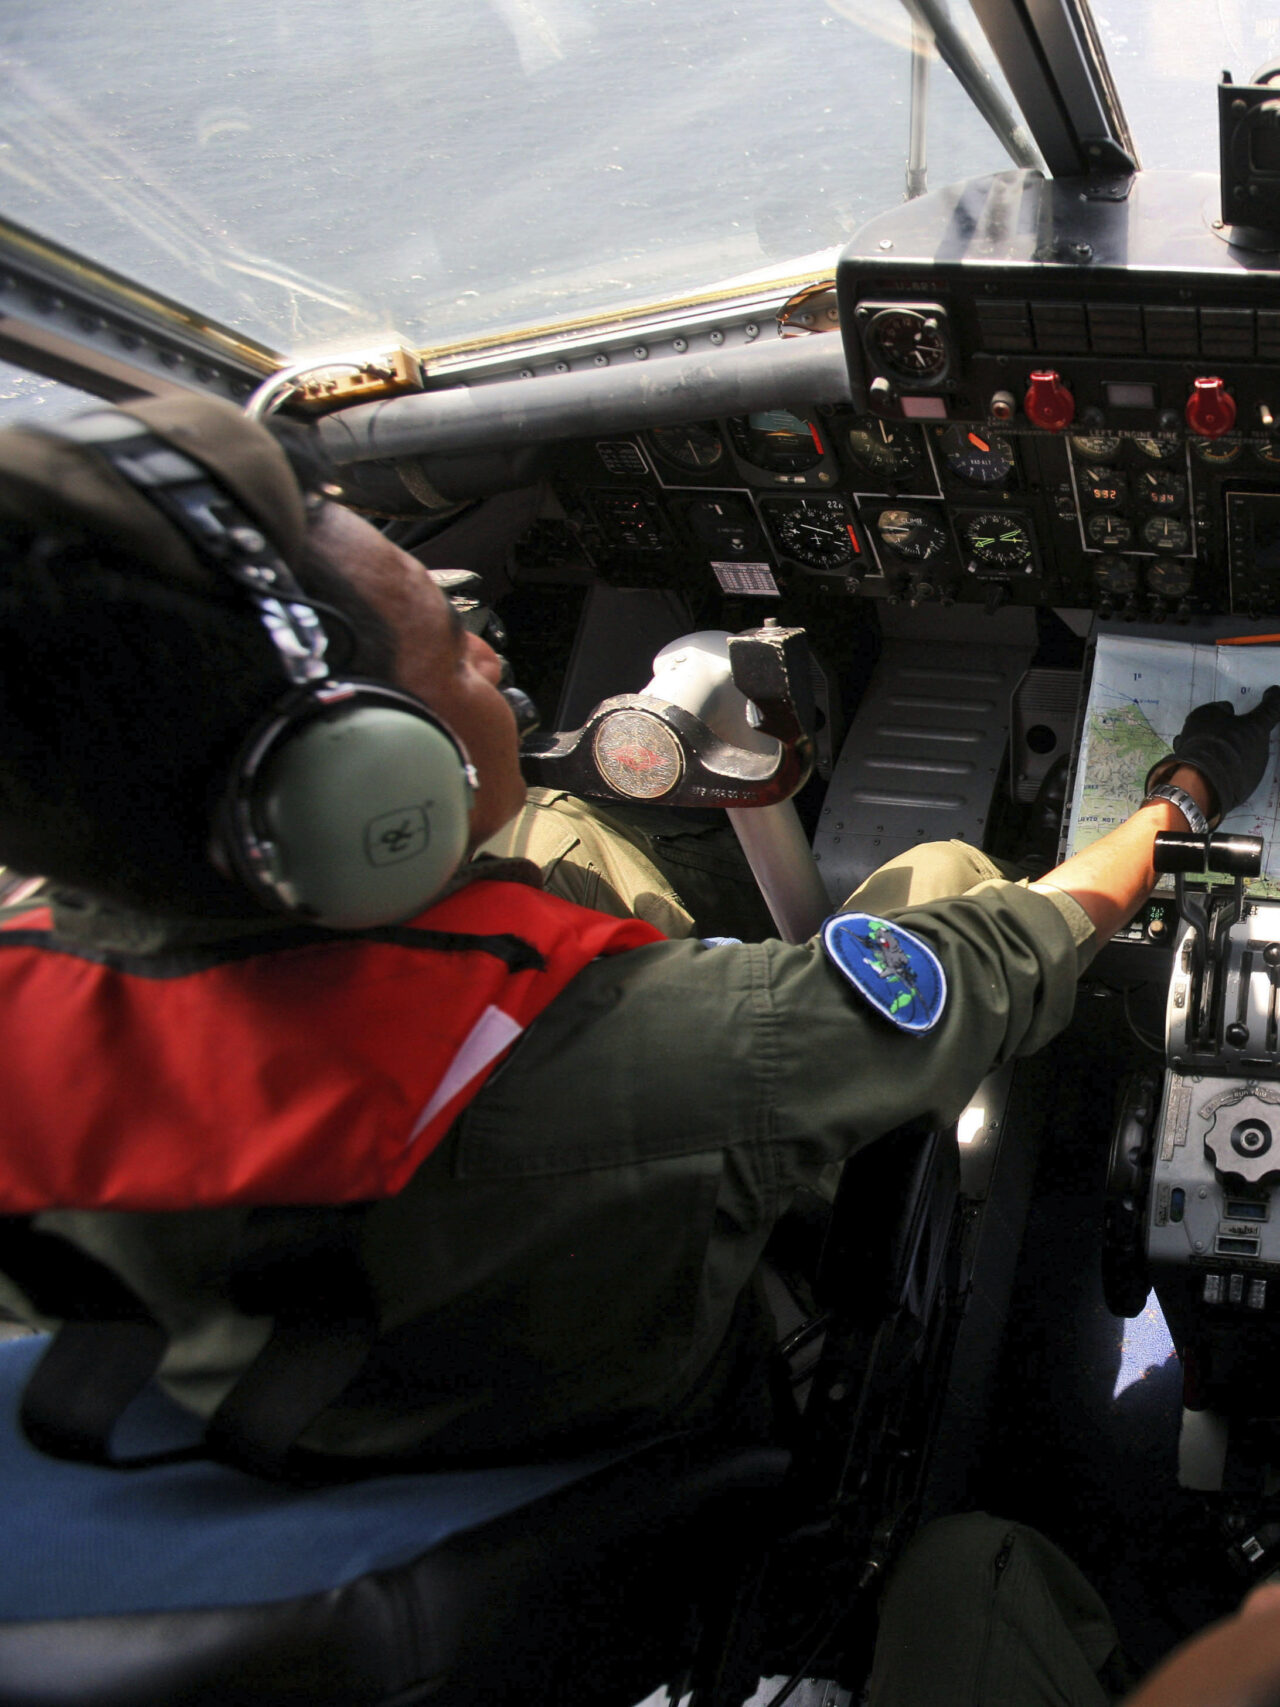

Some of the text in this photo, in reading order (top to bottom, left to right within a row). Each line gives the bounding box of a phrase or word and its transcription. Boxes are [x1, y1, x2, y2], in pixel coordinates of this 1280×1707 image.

[1089, 429, 1178, 440] LEFT ENGINE FIRE
